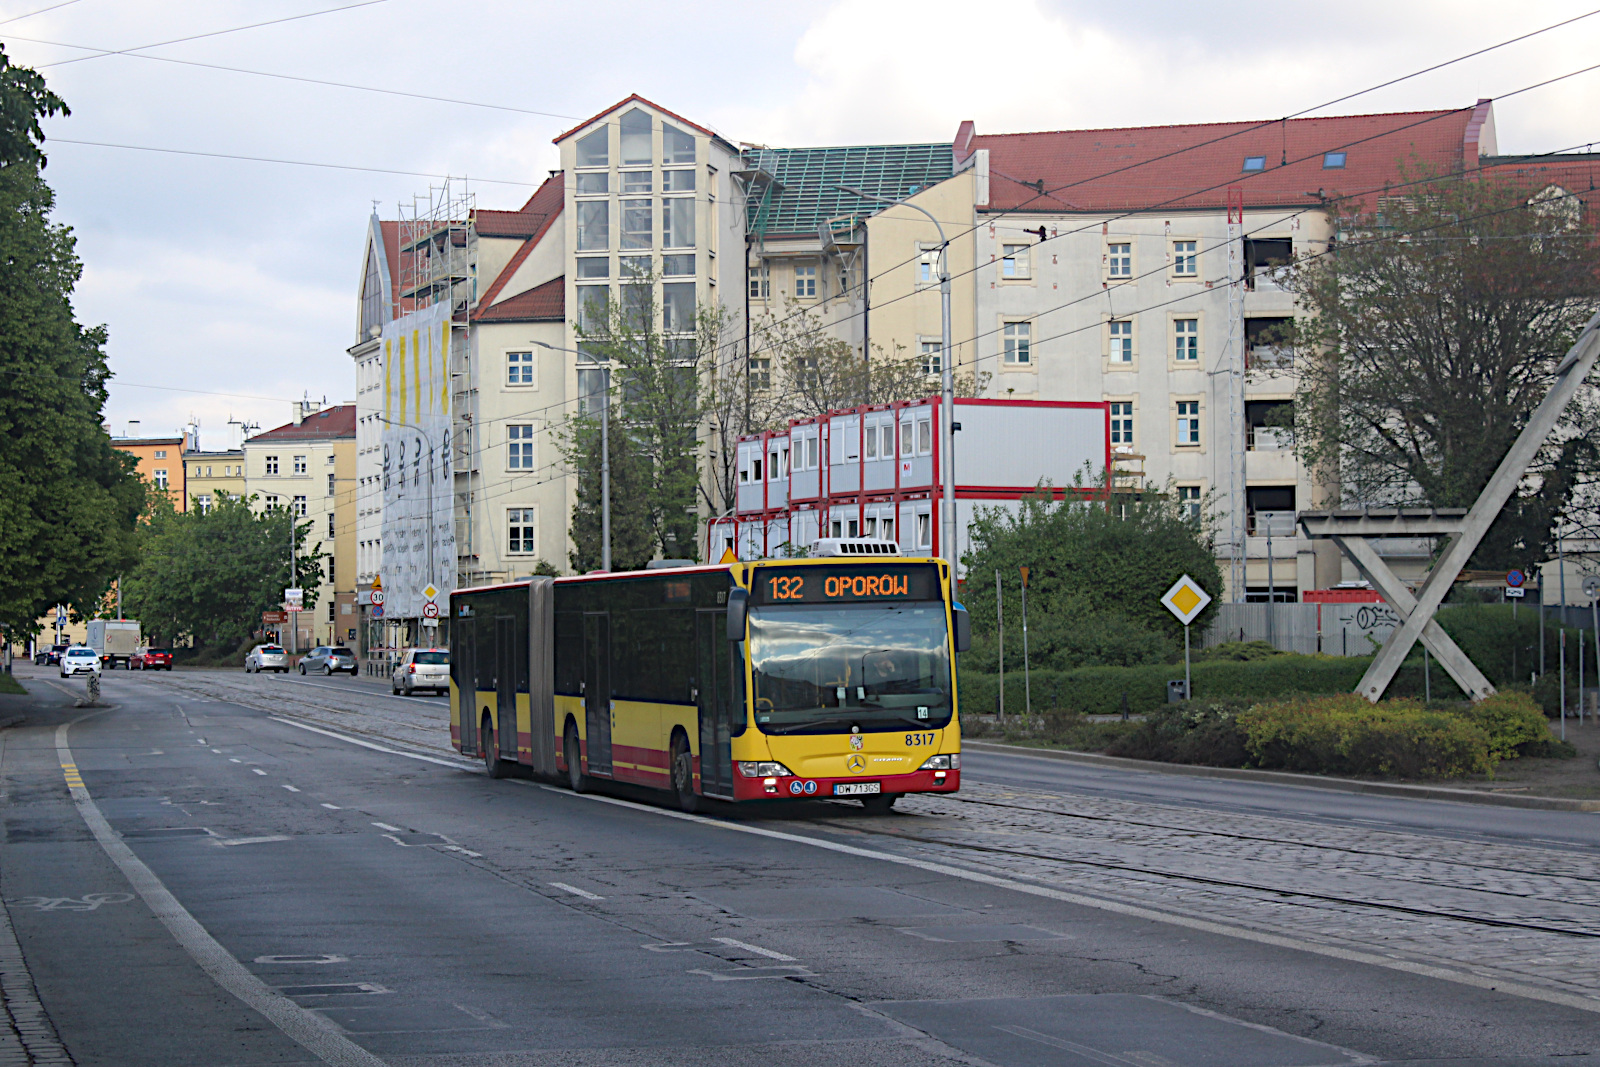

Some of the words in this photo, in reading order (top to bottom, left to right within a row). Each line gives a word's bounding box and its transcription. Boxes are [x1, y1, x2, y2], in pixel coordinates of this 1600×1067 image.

[769, 576, 804, 599] 132
[824, 574, 909, 597] OPORÓW
[373, 593, 384, 602] 30
[918, 708, 927, 718] 14
[905, 733, 935, 746] 8317
[838, 784, 851, 794] DW
[853, 783, 880, 793] 713GS
